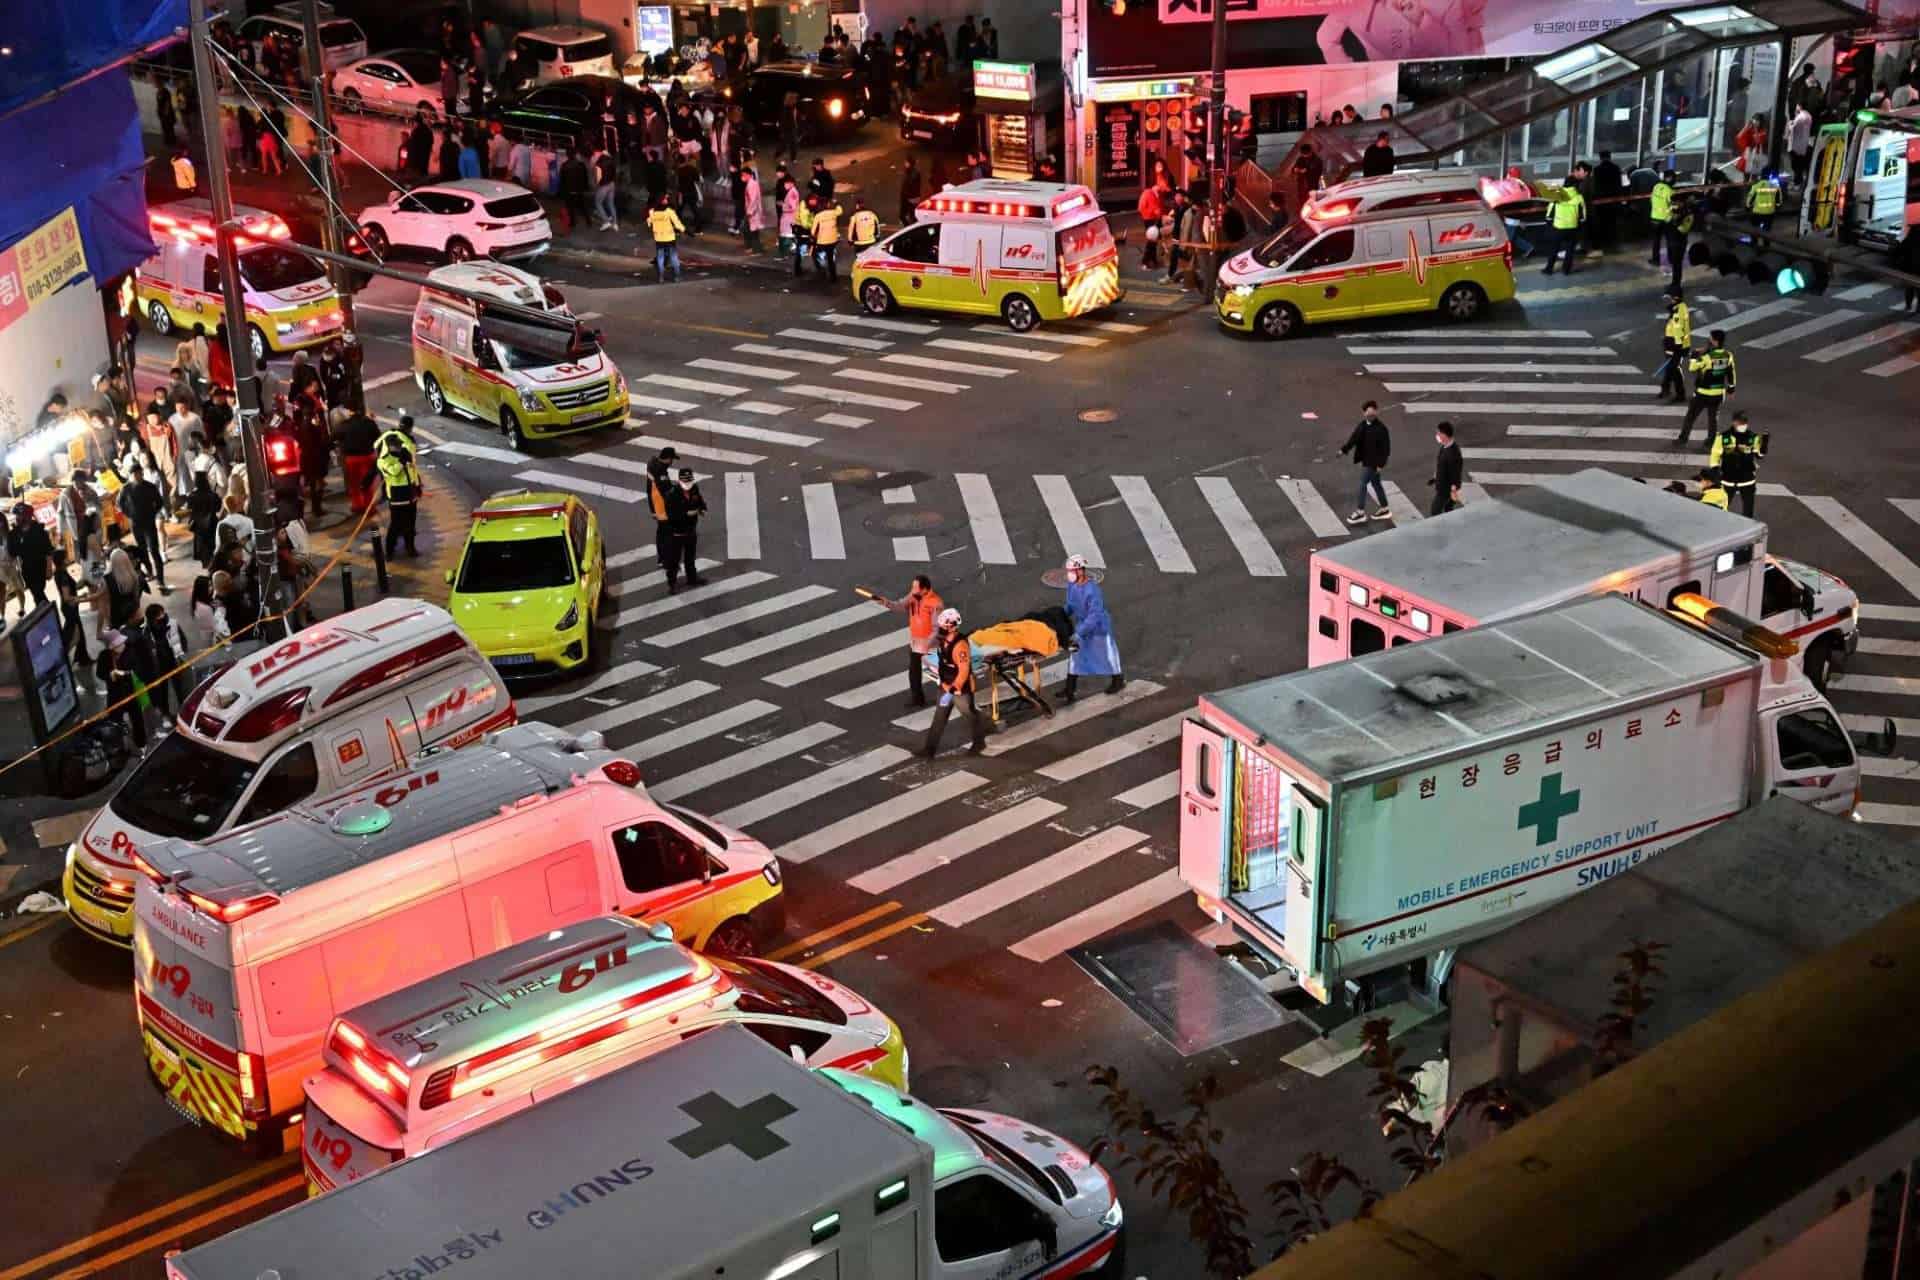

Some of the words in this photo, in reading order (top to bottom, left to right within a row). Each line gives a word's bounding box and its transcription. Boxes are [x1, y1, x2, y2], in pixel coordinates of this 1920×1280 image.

[1005, 243, 1033, 258] 119
[249, 641, 302, 677] 119
[426, 688, 467, 727] 119
[1419, 708, 1681, 799] 현장응급의료소
[374, 769, 440, 808] 119
[1398, 882, 1455, 910] MOBILE
[1459, 855, 1550, 893] EMERGENCY
[1555, 832, 1621, 863] SUPPORT
[1626, 819, 1660, 841] UNIT
[1577, 855, 1630, 887] SNUH
[151, 905, 209, 948] AMBULANCE
[1378, 922, 1427, 947] 서울특별시
[151, 959, 191, 999] 119
[558, 944, 627, 994] 119
[160, 1010, 204, 1046] AMBULANCE
[312, 1127, 353, 1171] 119
[548, 1158, 655, 1215] SNUH
